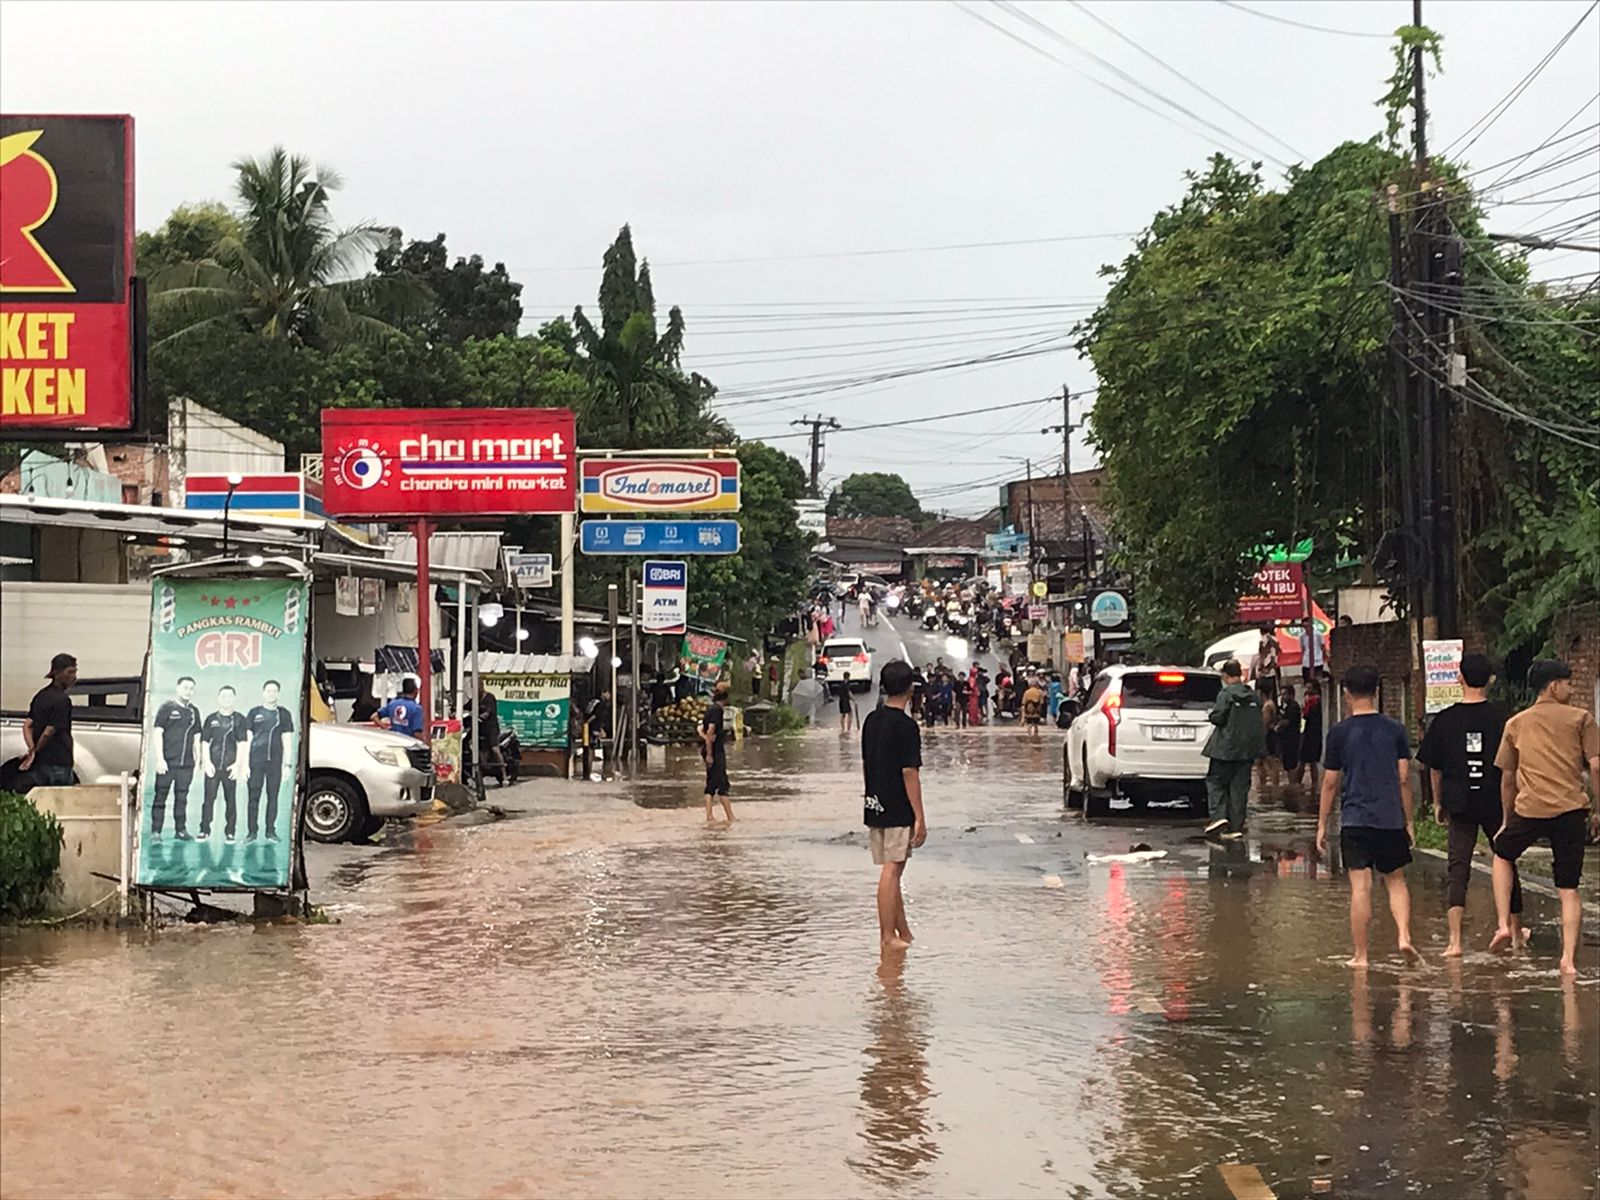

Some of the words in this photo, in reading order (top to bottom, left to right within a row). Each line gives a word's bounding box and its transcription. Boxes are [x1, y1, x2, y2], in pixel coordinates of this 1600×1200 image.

[400, 433, 465, 462] cha
[472, 433, 567, 461] mart
[400, 477, 469, 490] chandra
[471, 476, 504, 490] mini
[507, 476, 567, 490] market
[610, 475, 712, 495] Indomaret
[516, 566, 545, 576] ATM
[663, 569, 681, 580] BRI
[1274, 582, 1296, 594] IBU
[653, 598, 678, 607] ATM
[177, 615, 233, 639] PANGKAS
[235, 615, 283, 639] RAMBUT
[195, 631, 263, 669] ARI
